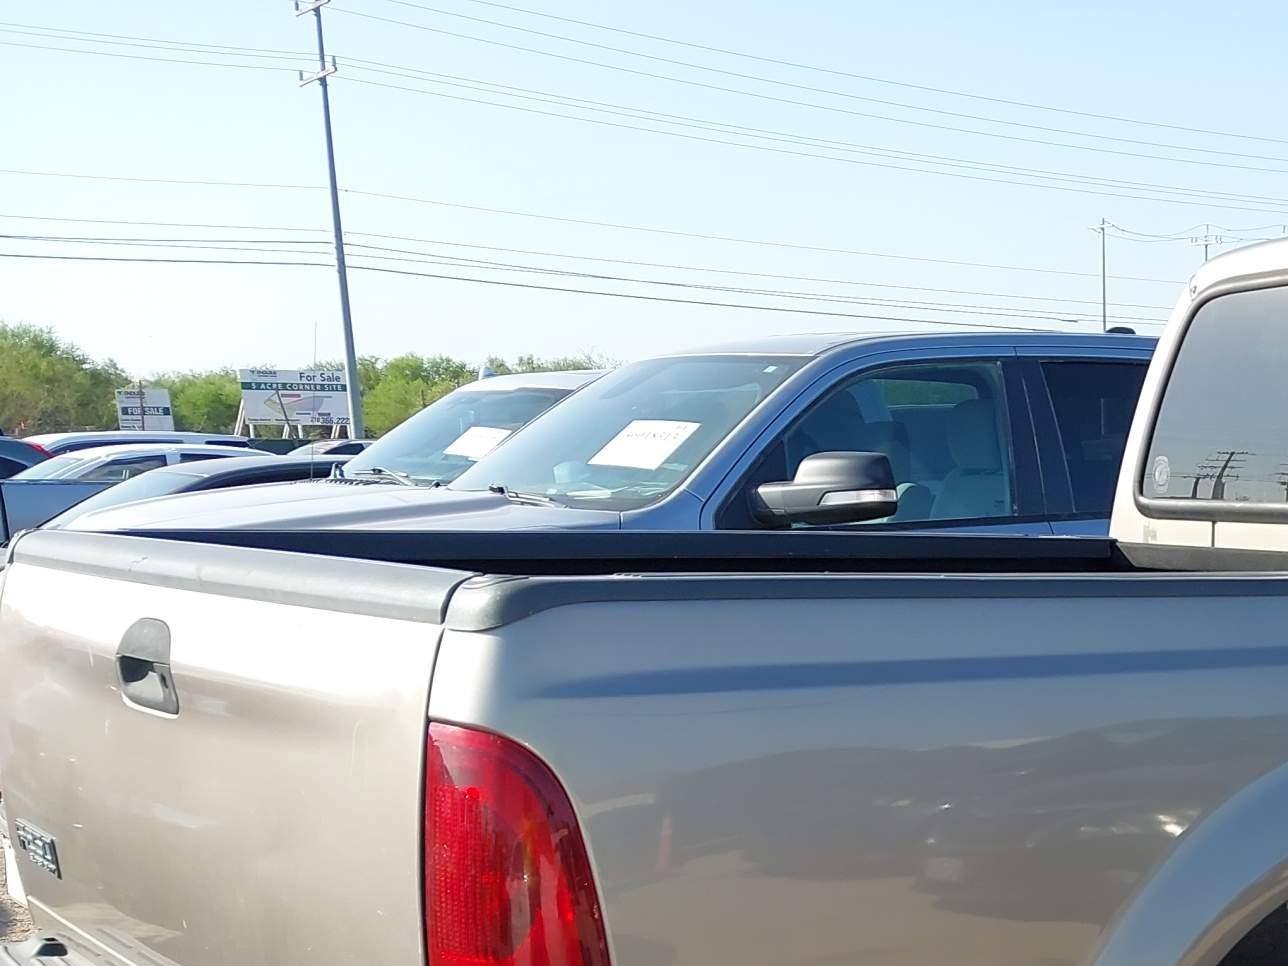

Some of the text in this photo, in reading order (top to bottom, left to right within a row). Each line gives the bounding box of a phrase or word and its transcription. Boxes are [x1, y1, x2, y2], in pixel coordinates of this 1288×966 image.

[299, 372, 341, 382] For Sale
[144, 407, 164, 415] SALE
